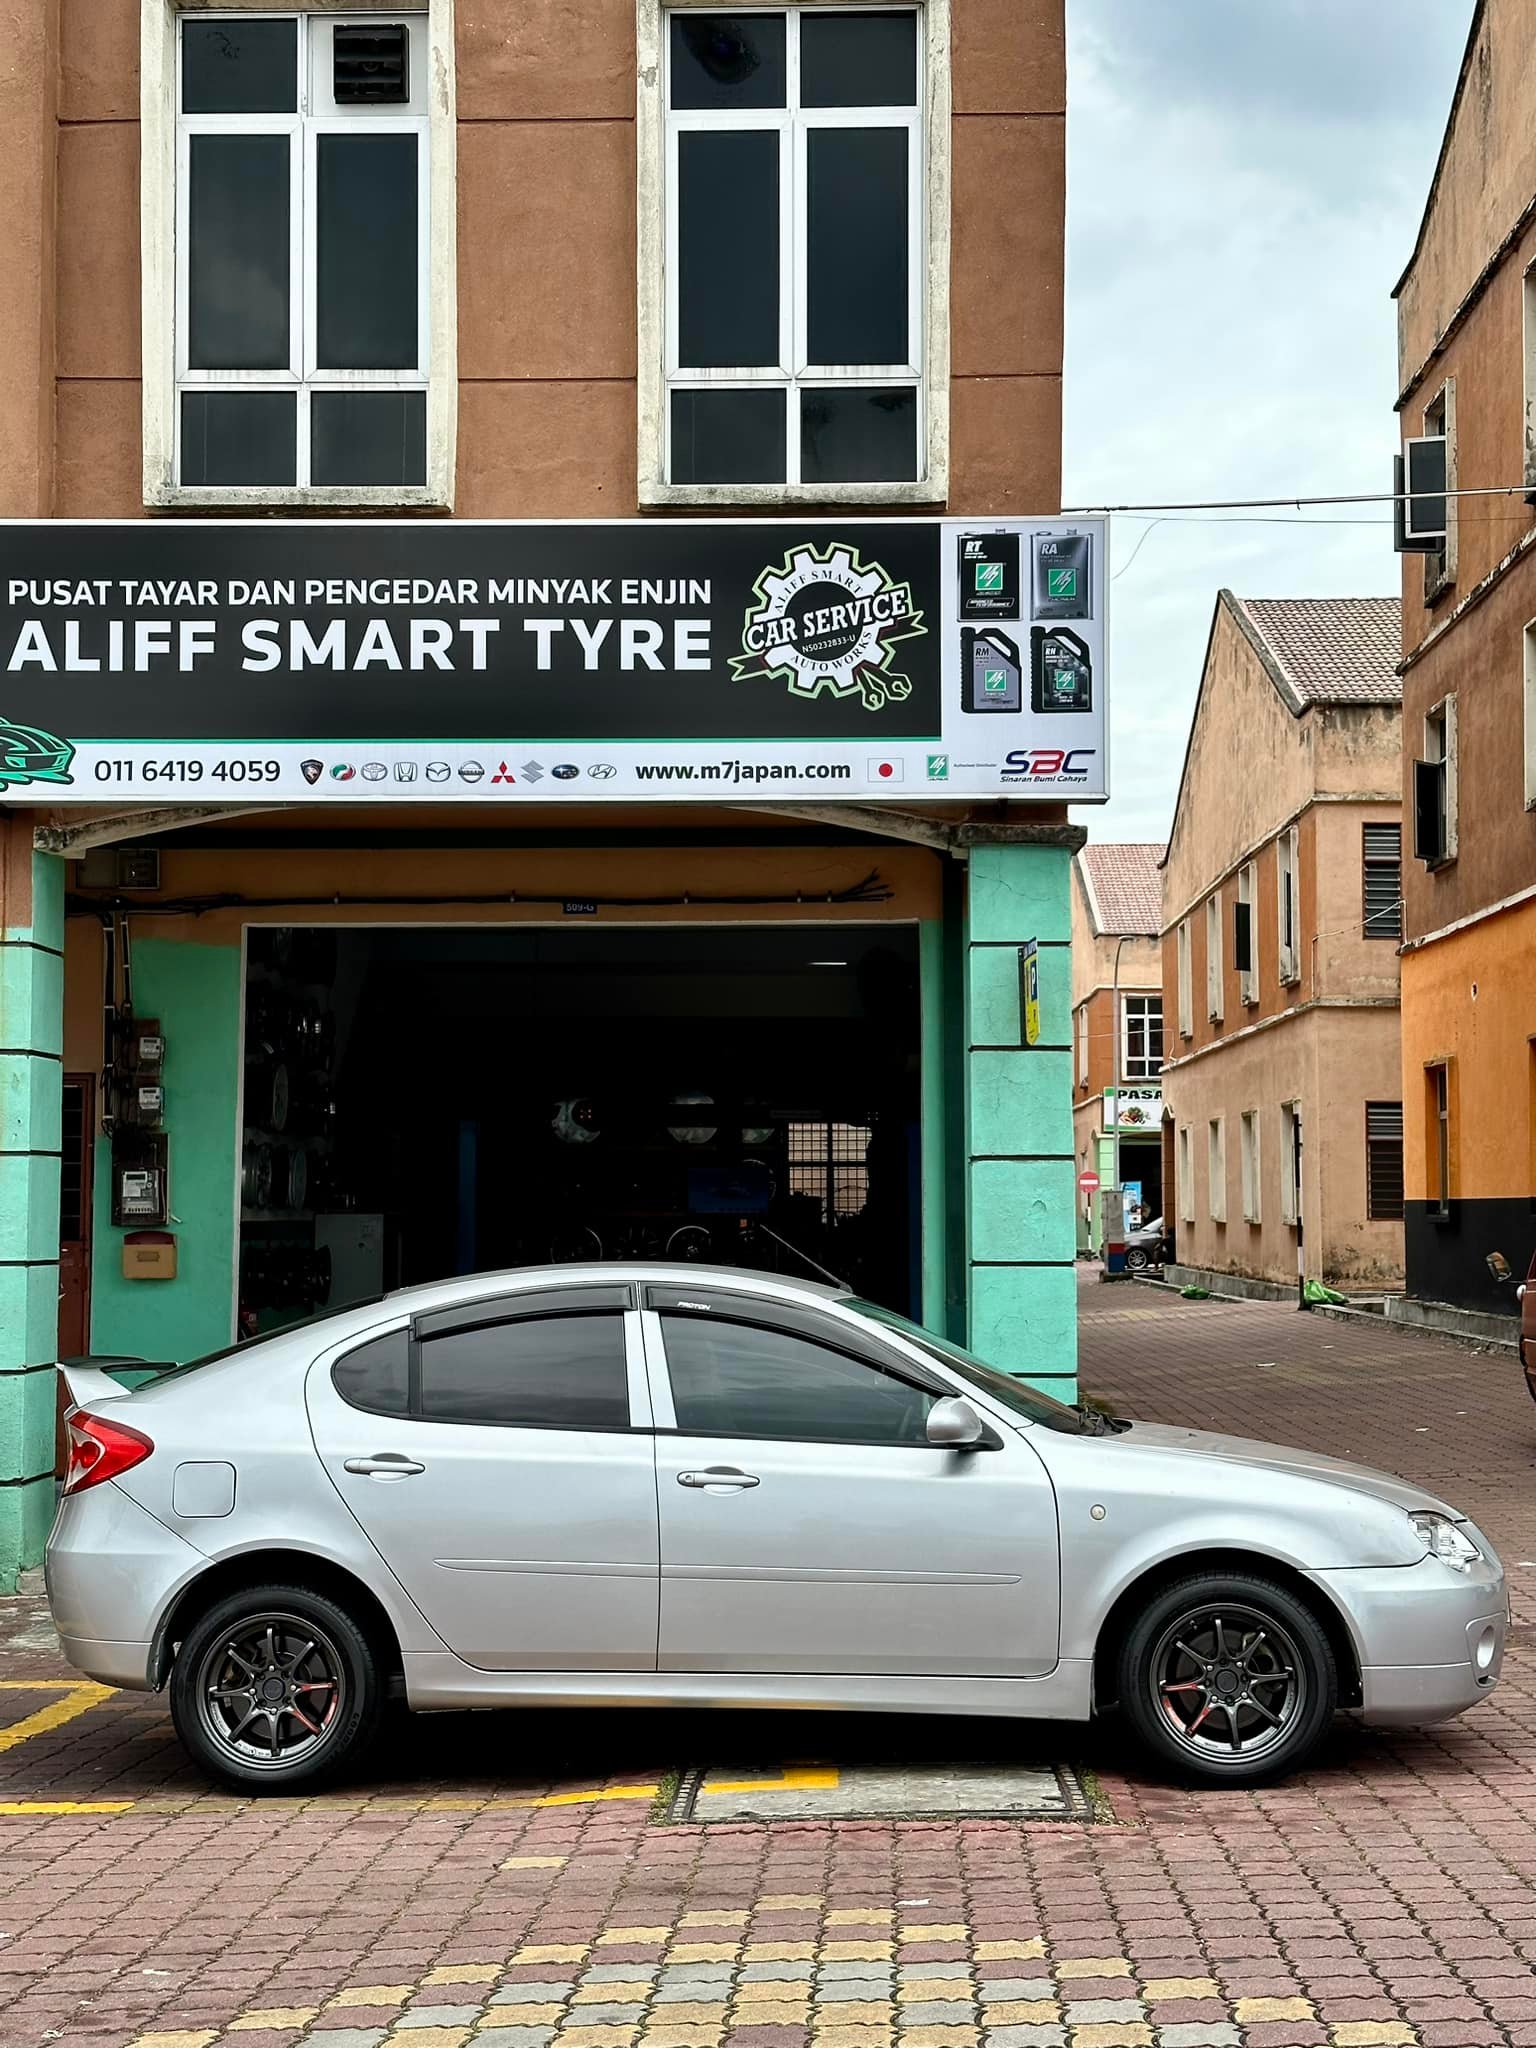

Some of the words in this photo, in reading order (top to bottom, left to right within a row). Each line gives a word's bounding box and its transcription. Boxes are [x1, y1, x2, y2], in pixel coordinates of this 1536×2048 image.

[965, 540, 984, 553] RT
[1041, 543, 1058, 555] RA
[8, 580, 112, 605] PUSAT
[120, 581, 218, 605] TAYAR
[229, 581, 295, 605] DAN
[306, 580, 478, 605] PENGEDAR
[489, 579, 612, 604] MINYAK
[622, 580, 711, 604] ENJIN
[775, 575, 808, 613] ALIFF
[811, 570, 864, 594] SMART
[747, 618, 798, 650] CAR
[803, 590, 906, 638] SERVICE
[7, 620, 215, 671] ALIFF
[242, 619, 500, 671] SMART
[524, 619, 711, 671] TYRE
[791, 655, 829, 672] AUTO
[832, 631, 872, 669] WORKS
[975, 647, 989, 656] RM
[95, 761, 133, 782] 011
[142, 761, 204, 782] 6419
[211, 761, 281, 782] 4059
[636, 761, 851, 784] www.m7japan.com
[1000, 749, 1096, 775] SBC
[1033, 775, 1056, 783] Bumi
[1057, 775, 1088, 784] Cahaya
